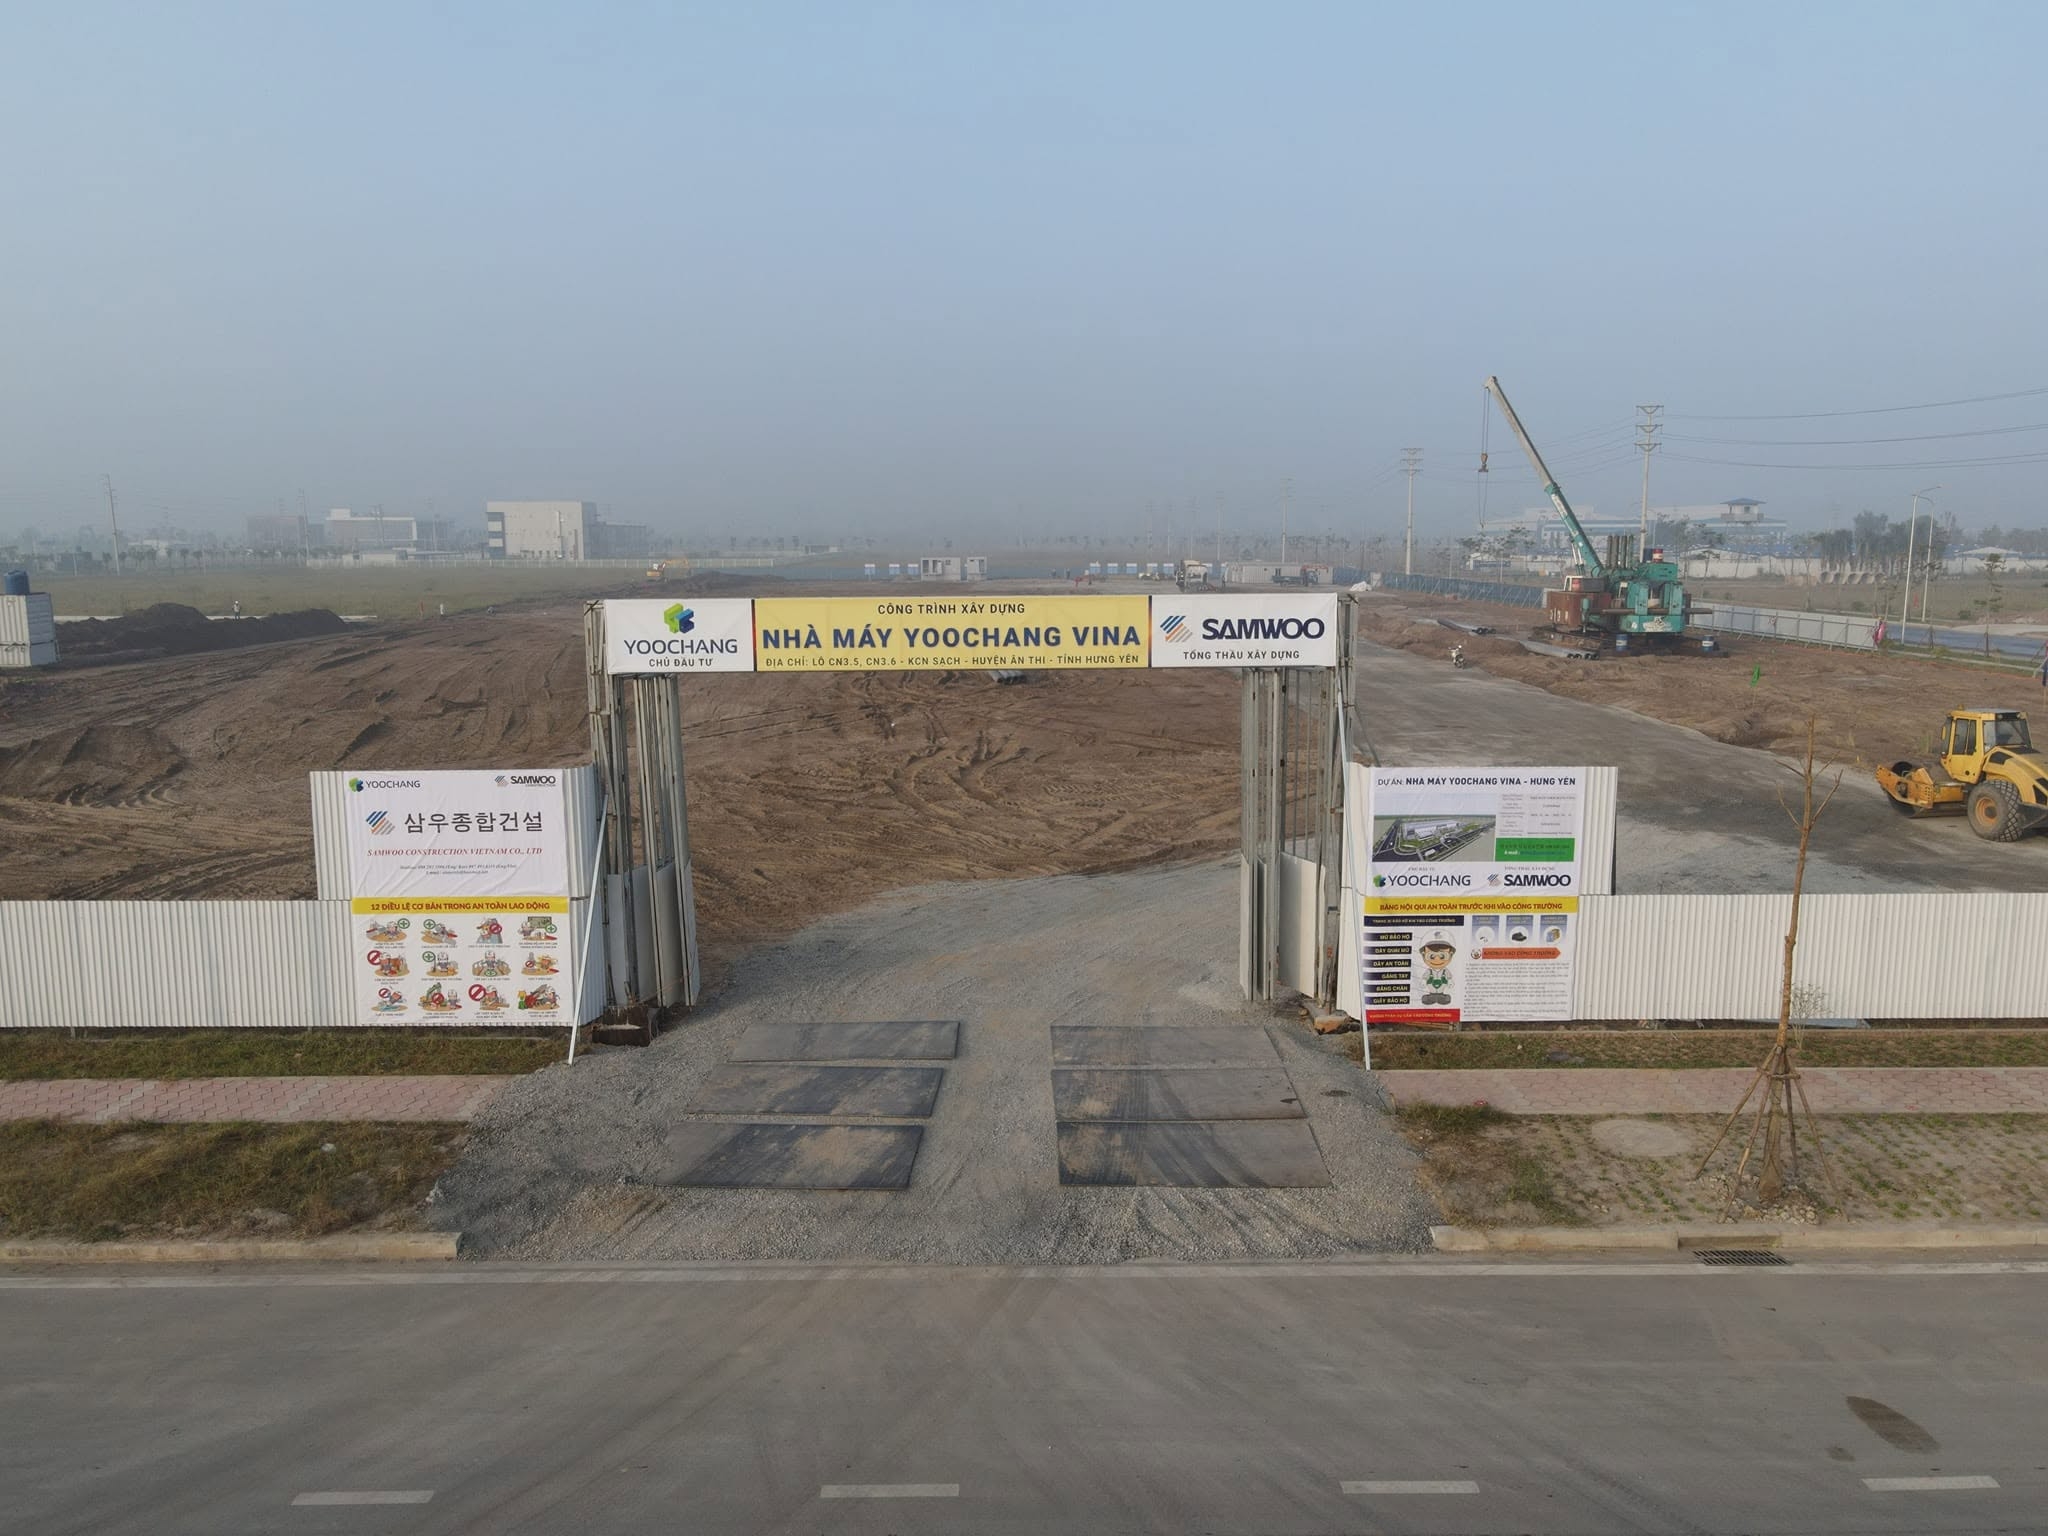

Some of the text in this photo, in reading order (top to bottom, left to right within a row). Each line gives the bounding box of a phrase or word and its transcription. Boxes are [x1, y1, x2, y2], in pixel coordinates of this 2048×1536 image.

[877, 602, 1025, 615] CÔNG TRÌNH XÂY DỰNG
[1201, 618, 1326, 641] SAMWOO
[762, 623, 1141, 649] NHÀ MÁY YOOCHANG VINA
[623, 639, 739, 655] YOOCHANG
[649, 656, 713, 667] CHỦ ĐẦU TƯ
[766, 658, 784, 668] ĐỊA
[787, 656, 809, 667] CHỈ:
[812, 656, 825, 666] LÔ
[828, 657, 863, 668] CN3.5,
[866, 657, 897, 666] CN3.6
[907, 657, 929, 666] KCN
[933, 656, 961, 667] SẠCH
[972, 655, 1007, 666] HUYỆN
[1010, 654, 1025, 664] ÂN
[1029, 656, 1046, 664] THI
[1057, 653, 1082, 664] TỈNH
[1085, 655, 1115, 664] HƯNG
[1119, 653, 1139, 664] YÊN
[1183, 649, 1300, 662] TỔNG THẦU XÂY DỰNG
[365, 780, 421, 789] YOOCHANG
[510, 775, 556, 785] SAMWOO
[1449, 777, 1498, 785] YOOCHANG
[1500, 777, 1521, 785] VINA
[404, 811, 544, 834] 삼우종합건설
[367, 848, 404, 857] SAMWOO
[405, 848, 468, 857] CONSTRUCTION
[470, 847, 508, 856] VIETNAM
[1388, 875, 1472, 887] YOOCHANG
[1503, 874, 1572, 887] SAMWOO
[371, 903, 381, 911] 12
[443, 903, 472, 911] TRONG
[485, 902, 508, 910] TOÀN
[508, 902, 525, 910] LAO
[526, 902, 551, 911] ĐỘNG
[1413, 903, 1427, 911] QUI
[1496, 902, 1512, 911] VÀO
[1512, 902, 1532, 910] CÔNG
